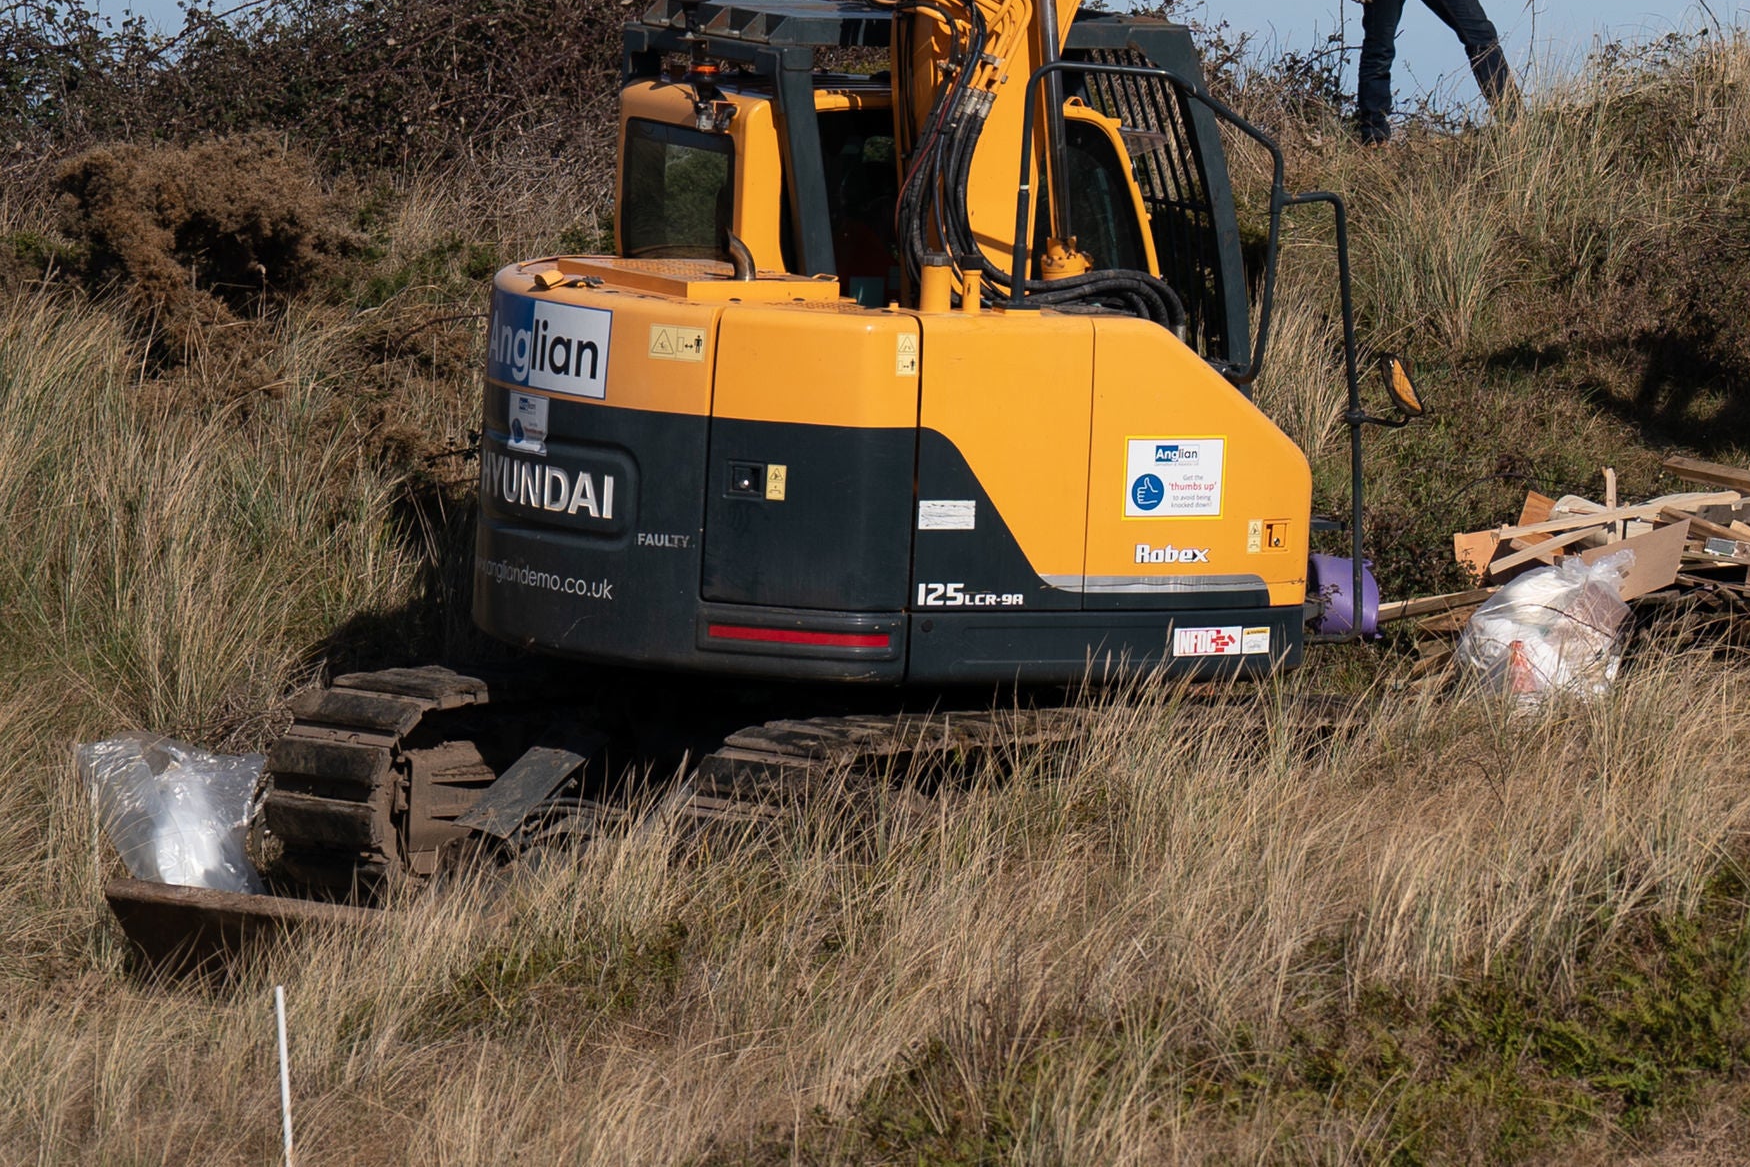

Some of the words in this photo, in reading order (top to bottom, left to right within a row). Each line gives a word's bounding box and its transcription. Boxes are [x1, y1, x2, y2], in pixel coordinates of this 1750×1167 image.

[488, 310, 599, 382] Anglian
[1156, 448, 1198, 462] Anglian
[482, 448, 615, 520] HYUNDAI
[637, 532, 690, 549] FAULTY
[1135, 544, 1211, 563] Robex
[1179, 629, 1221, 654] NFDC
